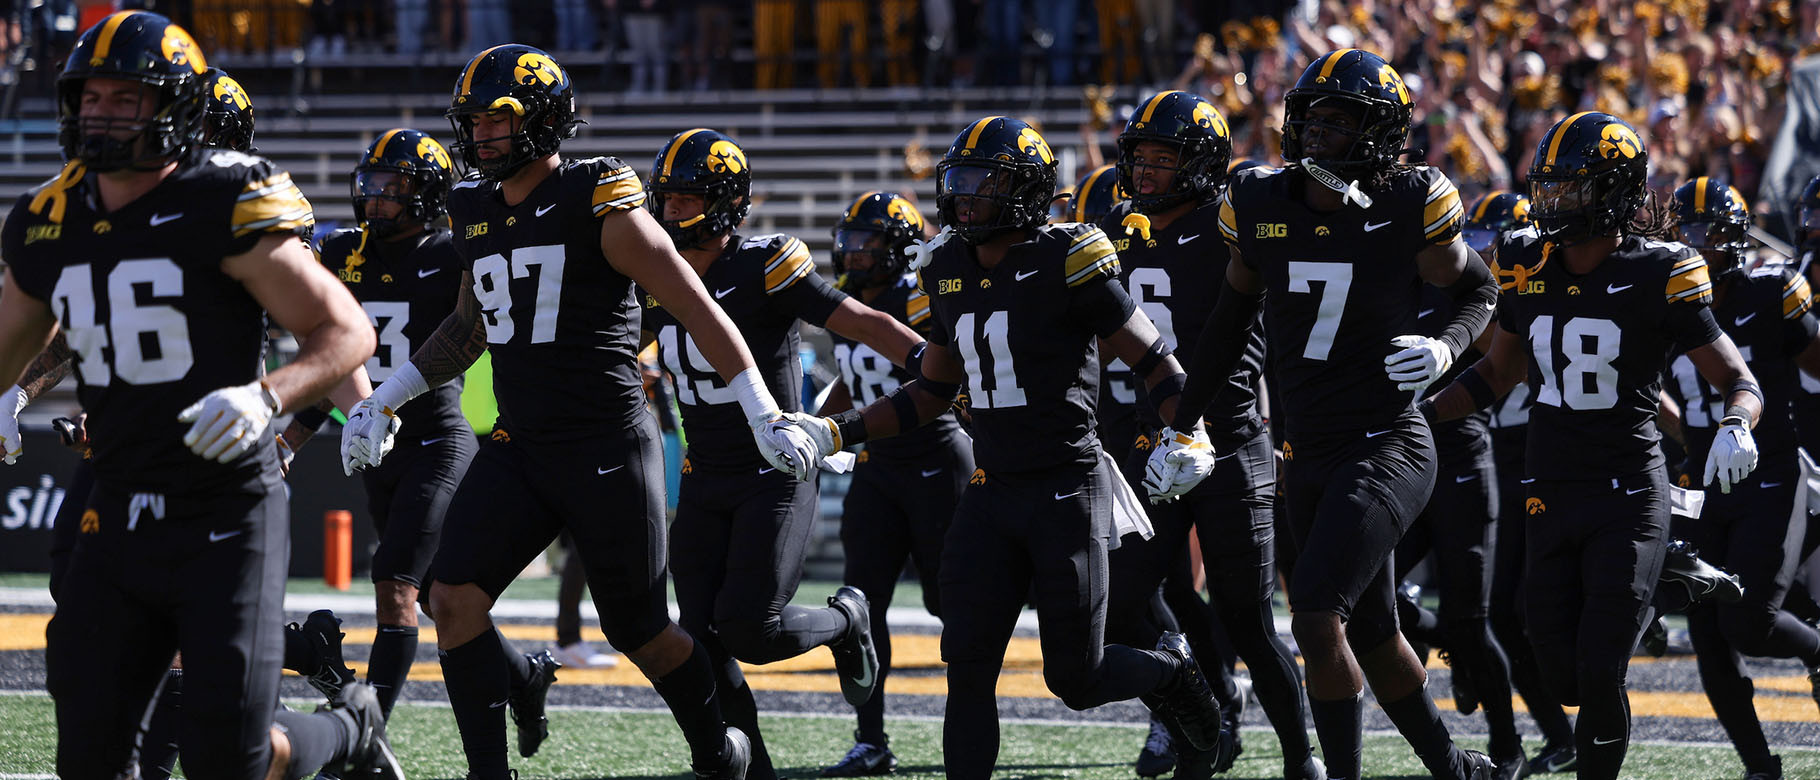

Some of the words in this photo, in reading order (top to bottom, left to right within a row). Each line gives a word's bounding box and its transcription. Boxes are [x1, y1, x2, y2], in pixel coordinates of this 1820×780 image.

[50, 256, 194, 387] 46
[472, 244, 566, 345] 97
[1128, 266, 1179, 356] 6
[1287, 261, 1355, 361] 7
[953, 310, 1026, 409] 11
[1527, 315, 1622, 411] 18
